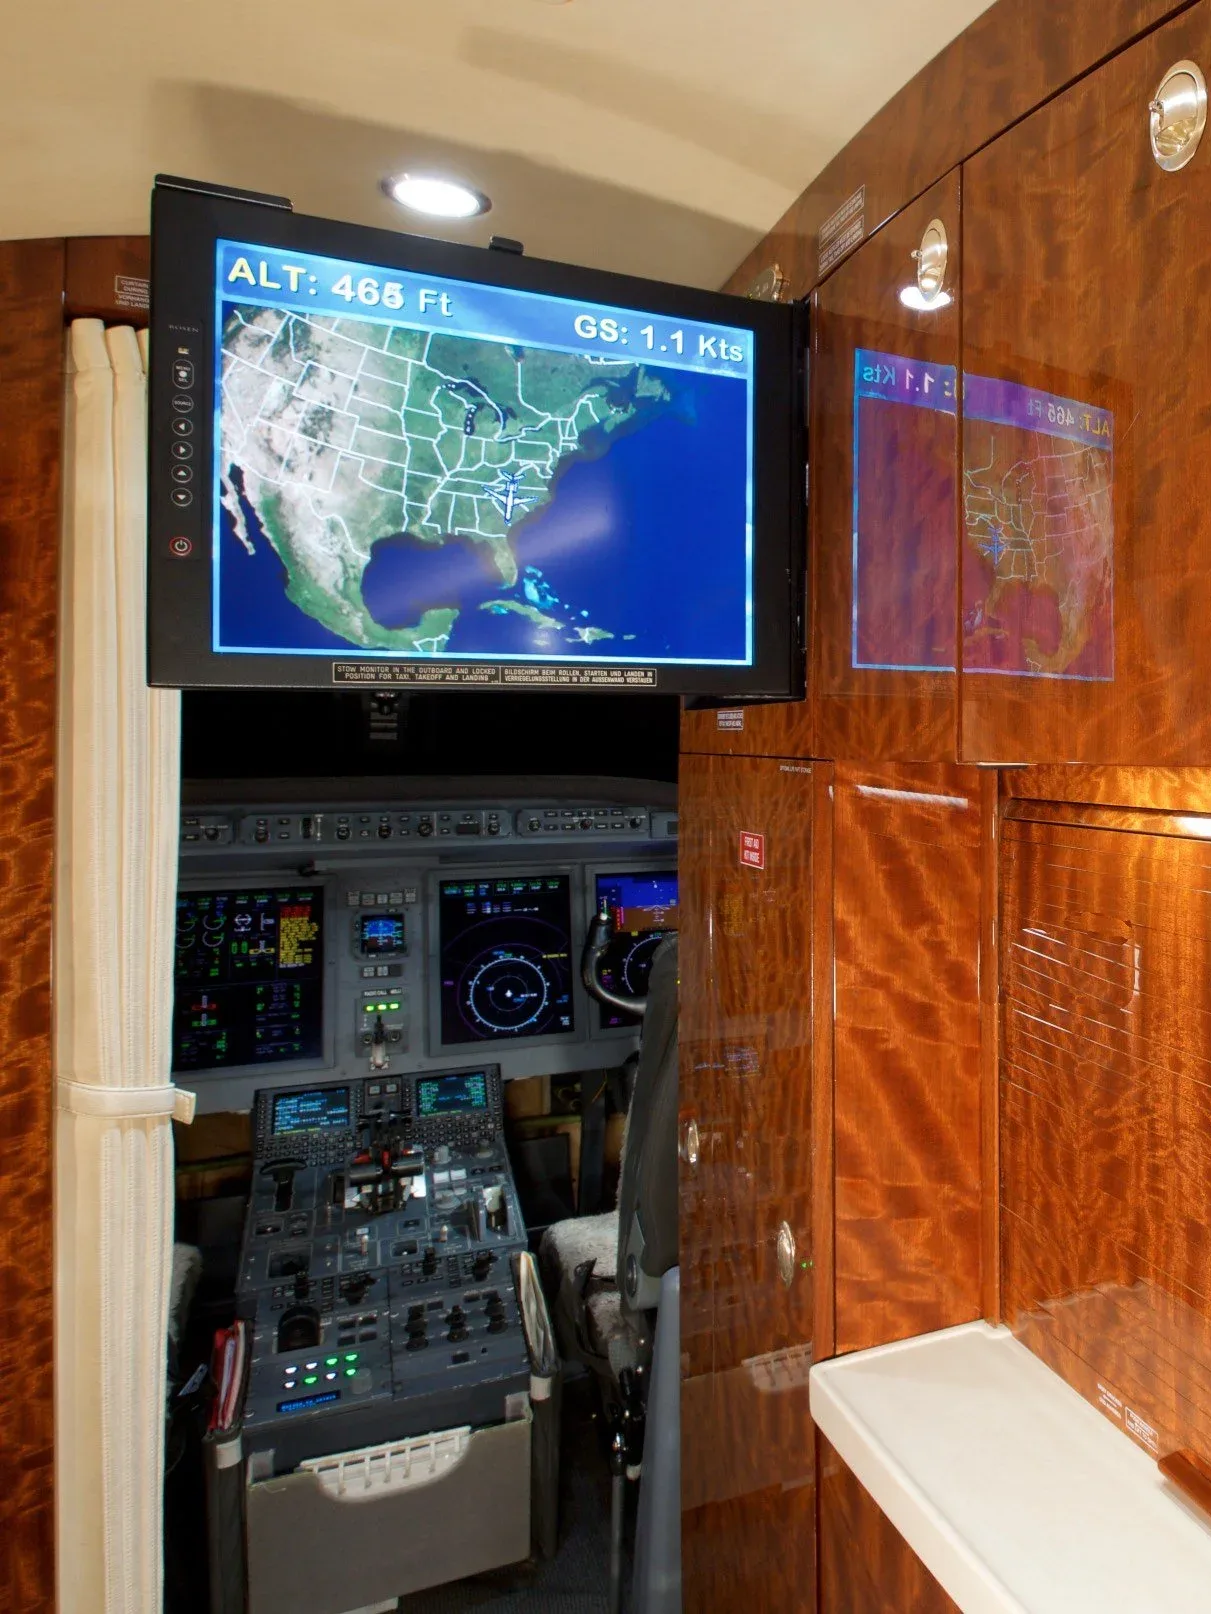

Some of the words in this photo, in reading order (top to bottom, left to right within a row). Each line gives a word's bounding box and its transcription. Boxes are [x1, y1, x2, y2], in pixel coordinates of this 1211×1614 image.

[228, 257, 318, 296] ALT:
[418, 288, 453, 317] Ft
[573, 314, 629, 345] GS:
[640, 325, 684, 354] 1.1
[698, 334, 744, 362] Kts
[404, 666, 416, 674] THE
